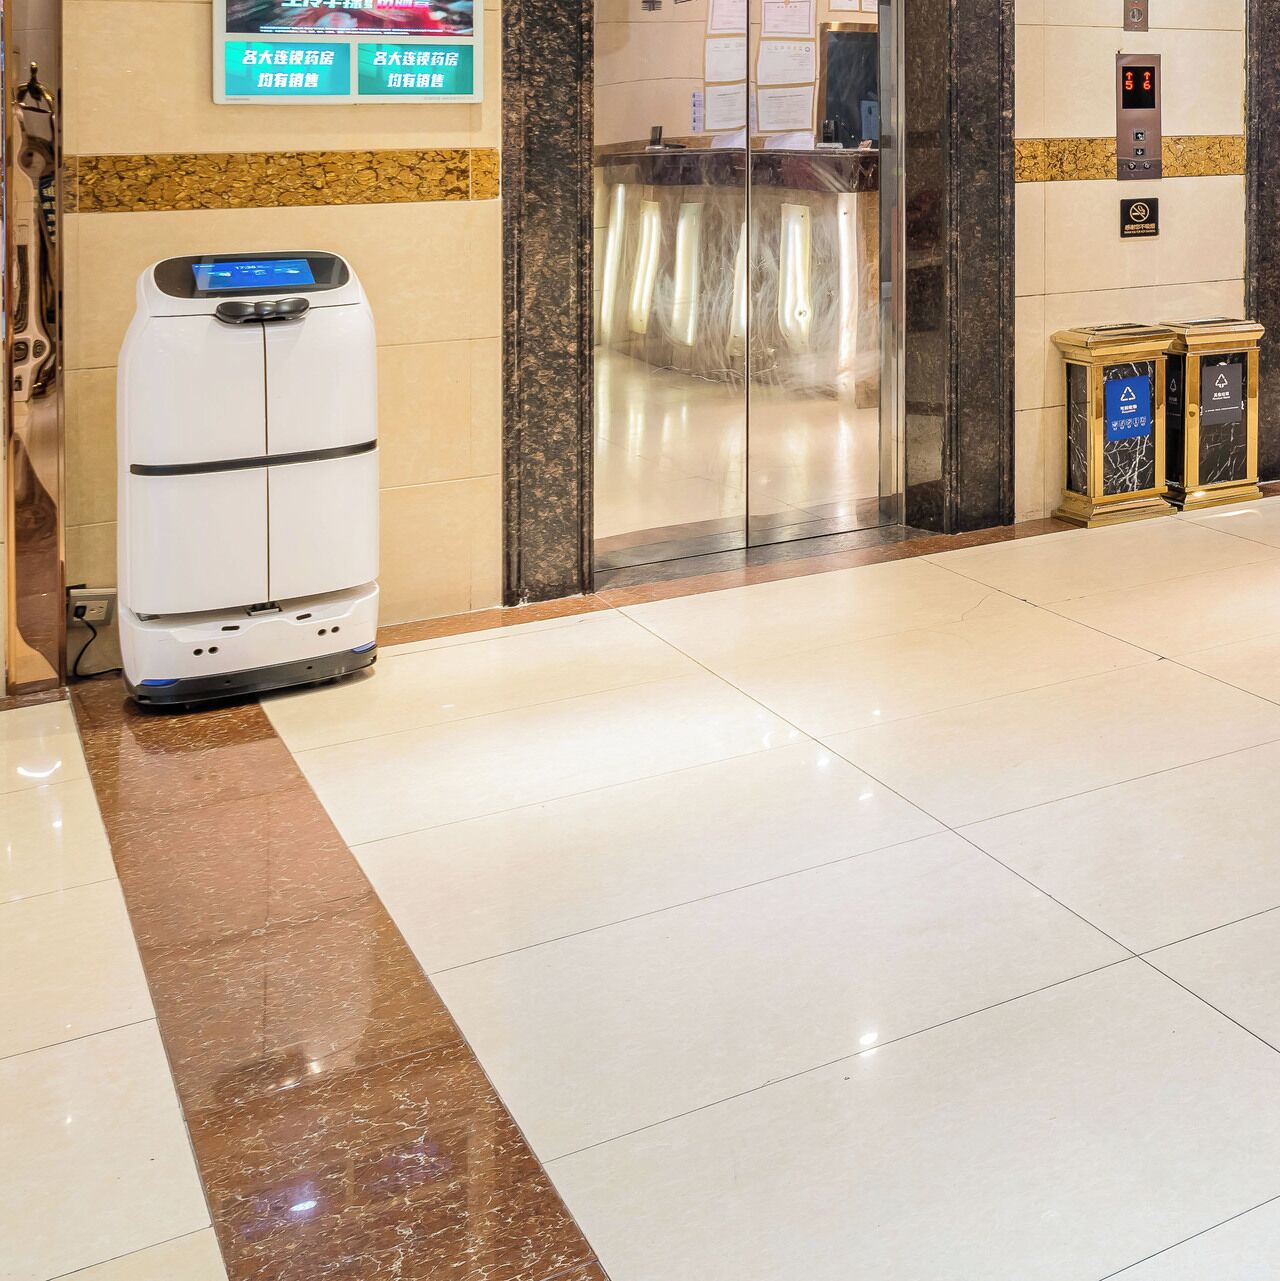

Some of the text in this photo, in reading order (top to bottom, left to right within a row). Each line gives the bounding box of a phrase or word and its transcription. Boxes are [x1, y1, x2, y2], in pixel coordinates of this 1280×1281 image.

[242, 50, 335, 66] 各大连锁药房
[373, 51, 459, 67] 各大连锁药房
[257, 73, 319, 89] 均有销售
[387, 73, 445, 89] 均有销售
[1125, 80, 1151, 90] 5 6
